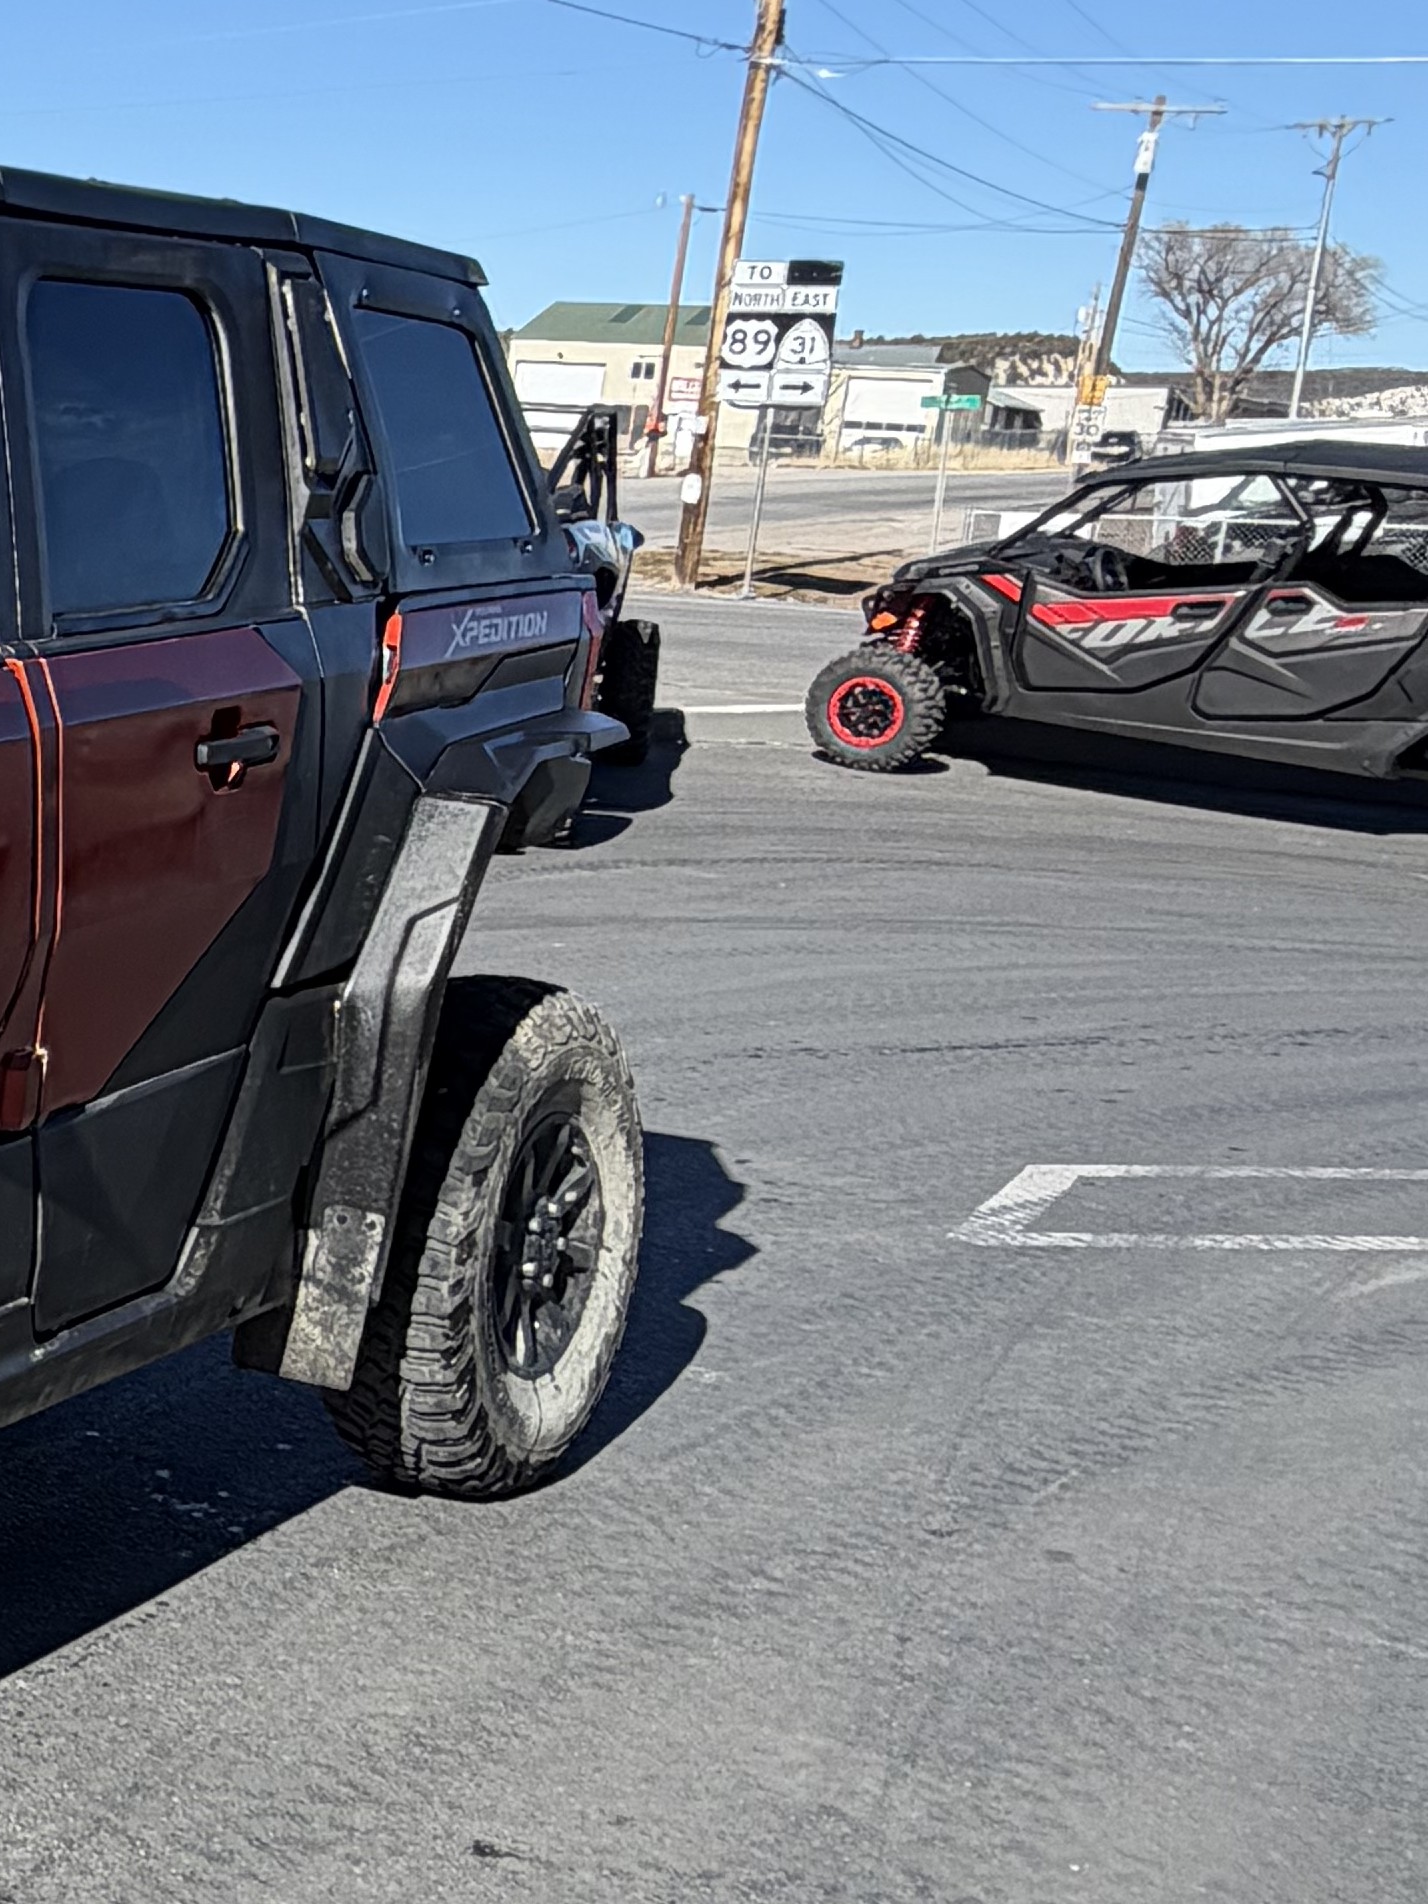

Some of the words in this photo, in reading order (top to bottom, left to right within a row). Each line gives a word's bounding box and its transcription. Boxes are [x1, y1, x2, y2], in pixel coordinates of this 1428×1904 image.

[747, 265, 773, 280] TO
[732, 292, 781, 306] NORTH
[791, 291, 831, 308] EAST
[728, 328, 772, 356] 89
[789, 336, 816, 354] 31
[445, 608, 548, 659] XPEDITION
